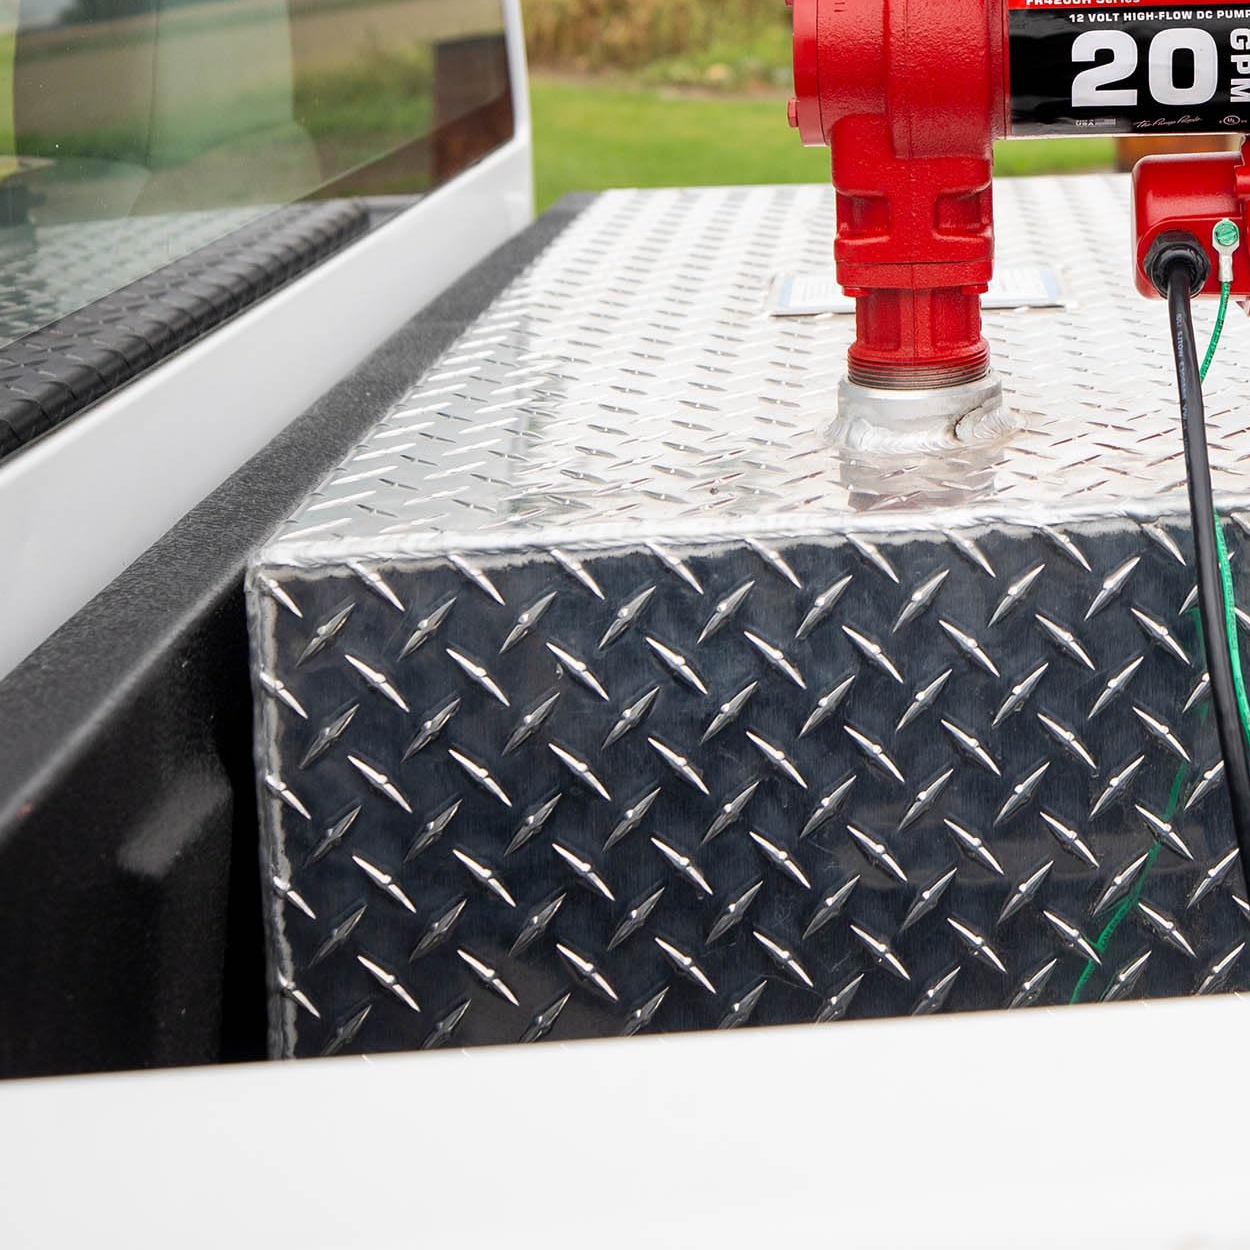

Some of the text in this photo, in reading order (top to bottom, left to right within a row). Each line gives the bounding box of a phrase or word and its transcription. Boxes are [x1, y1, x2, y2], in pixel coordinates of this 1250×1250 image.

[1069, 14, 1084, 23] 12
[1088, 13, 1120, 22] VOLT
[1123, 11, 1192, 22] HIGH-FLOW
[1196, 10, 1213, 19] DC
[1071, 27, 1218, 107] 20
